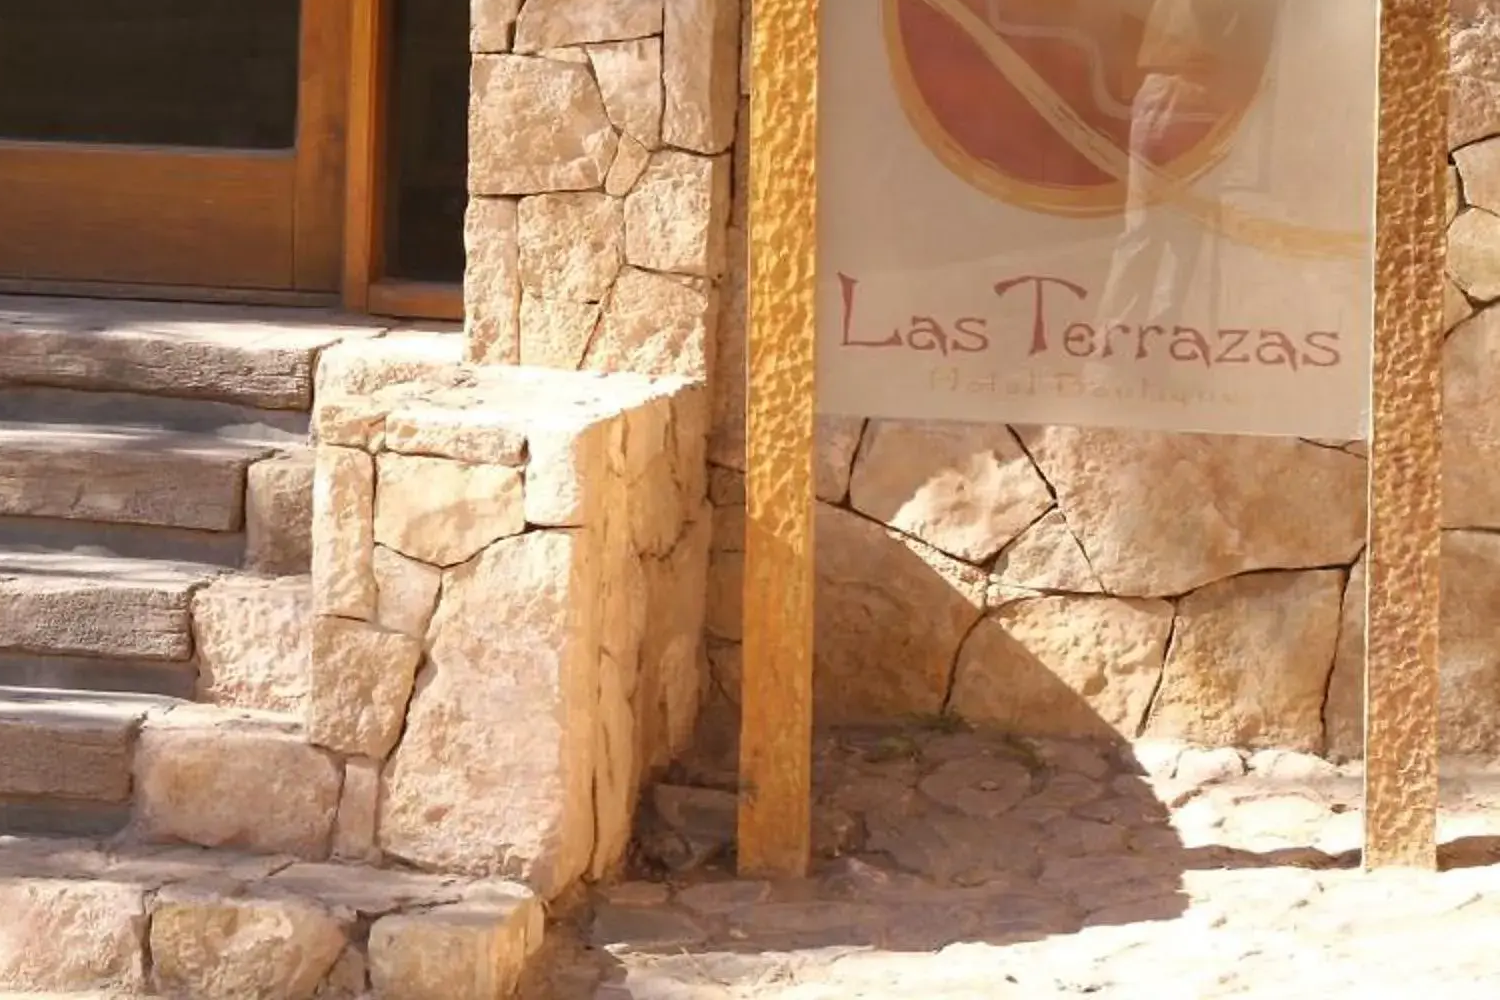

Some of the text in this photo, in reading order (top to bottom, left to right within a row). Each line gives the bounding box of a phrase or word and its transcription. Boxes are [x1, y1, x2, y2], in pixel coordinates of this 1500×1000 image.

[837, 271, 1342, 372] Las Terrazas
[928, 367, 1037, 396] Hotel
